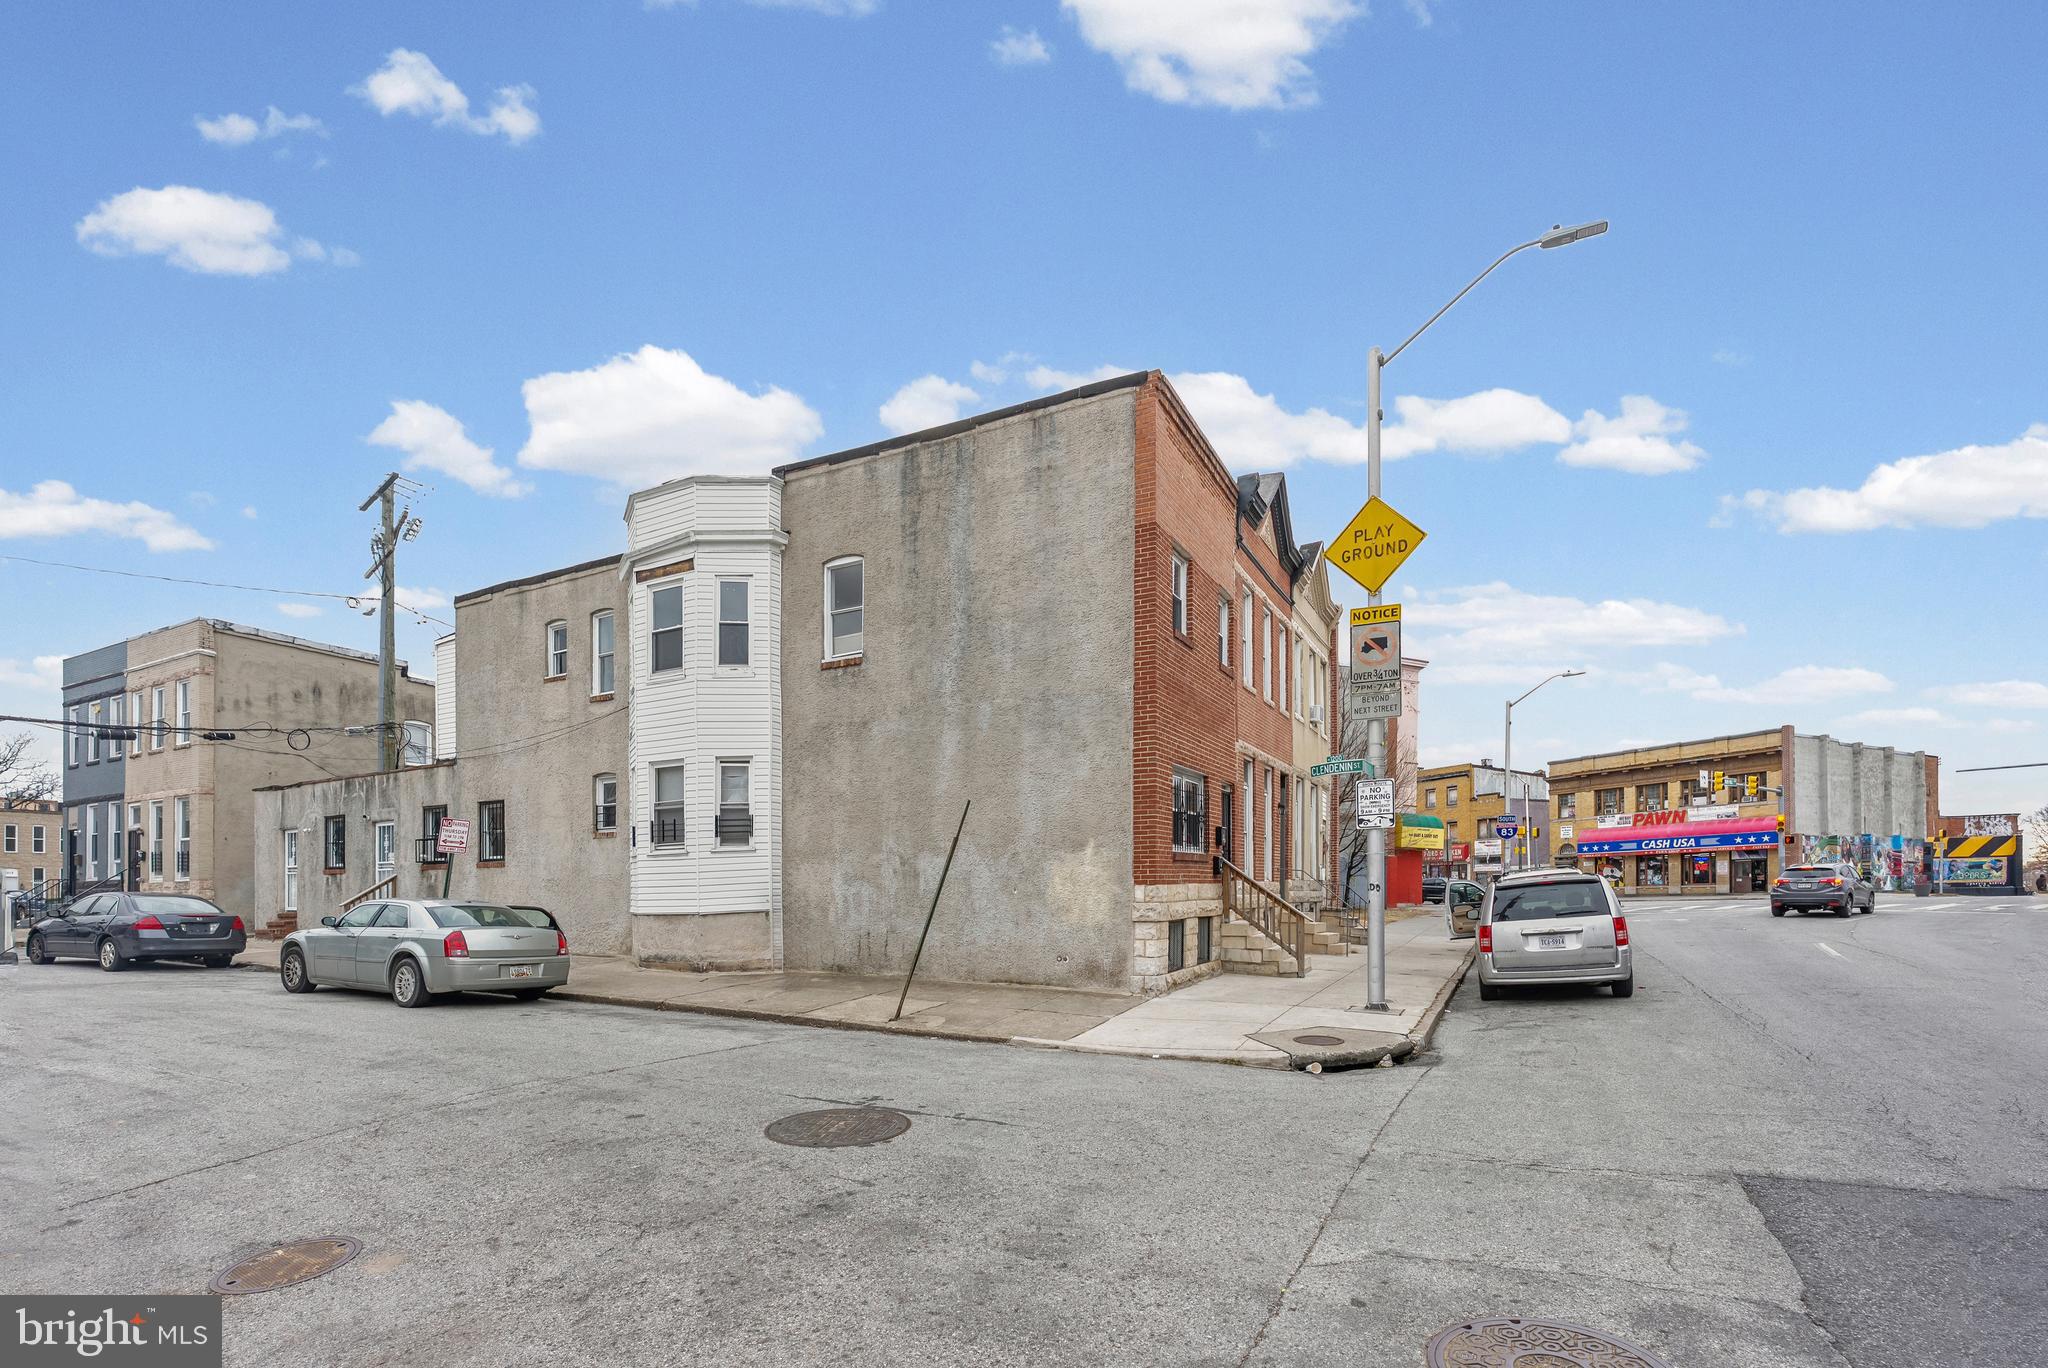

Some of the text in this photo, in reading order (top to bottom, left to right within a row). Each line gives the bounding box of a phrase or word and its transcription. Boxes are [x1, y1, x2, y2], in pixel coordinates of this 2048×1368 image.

[1354, 523, 1394, 543] PLAY
[1341, 539, 1408, 563] GROUND
[1353, 607, 1399, 621] NOTICE
[1353, 671, 1373, 681] OVER
[1383, 669, 1398, 678] TON
[1361, 695, 1390, 703] BEYOND
[1354, 704, 1398, 714] NEXT STREET
[1311, 761, 1353, 776] CLENDENIN
[442, 819, 452, 827] NO
[1632, 810, 1687, 827] PAWN
[1501, 828, 1514, 836] 83
[1641, 838, 1696, 849] CASH USA
